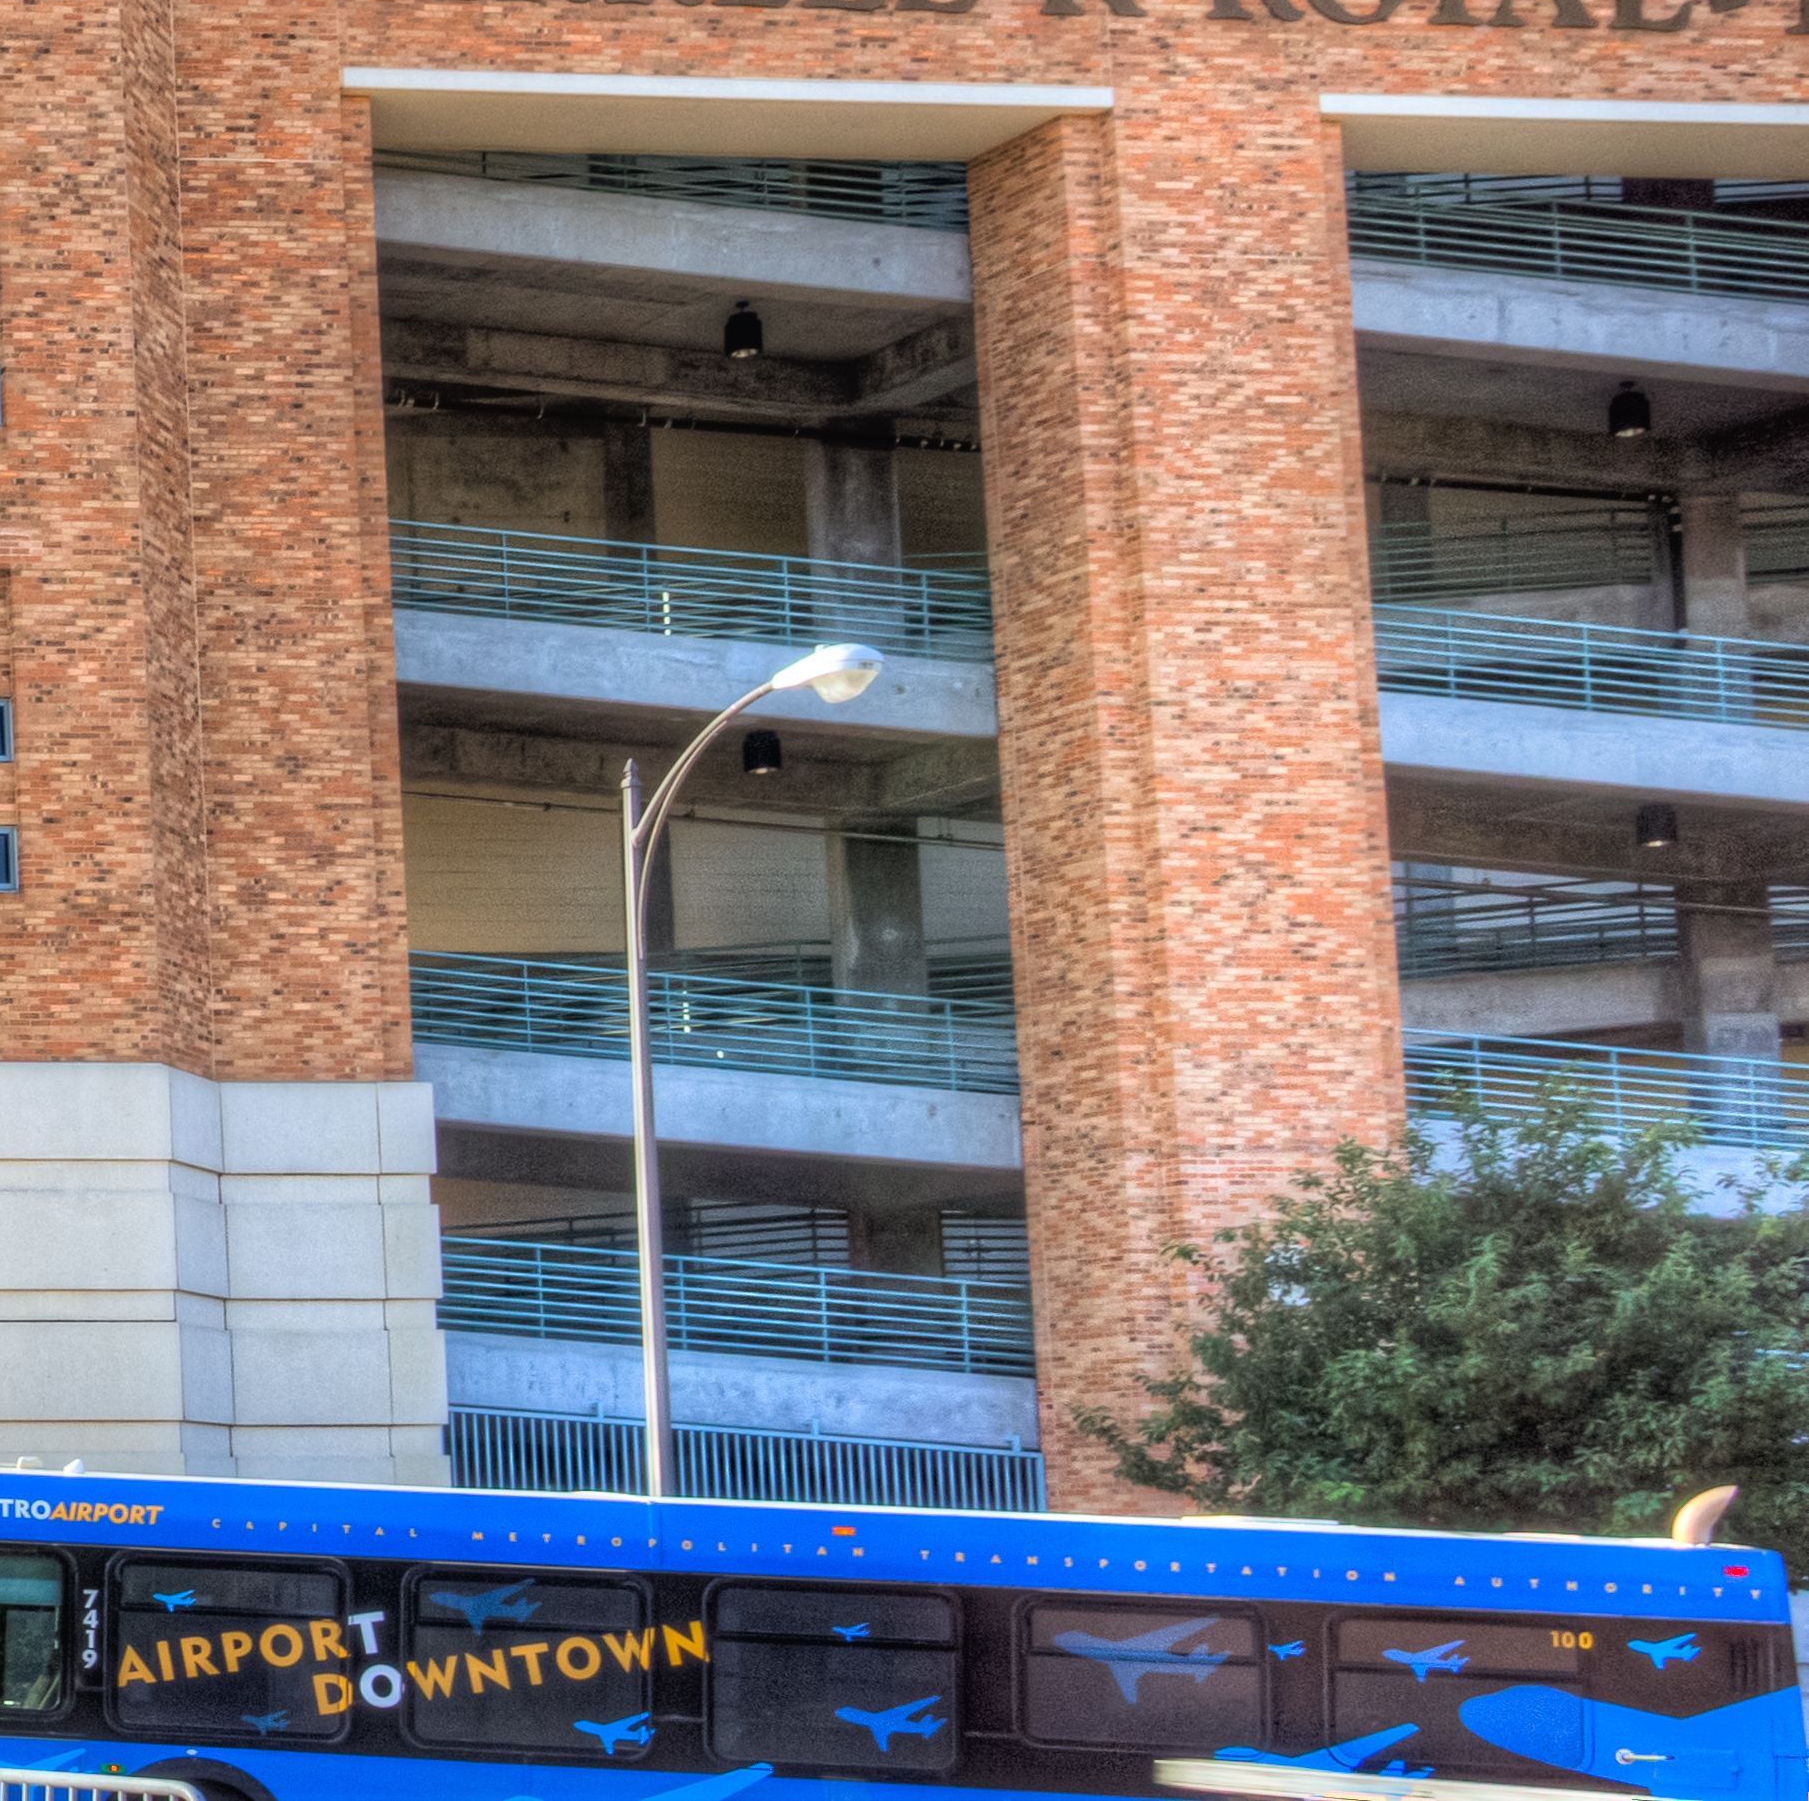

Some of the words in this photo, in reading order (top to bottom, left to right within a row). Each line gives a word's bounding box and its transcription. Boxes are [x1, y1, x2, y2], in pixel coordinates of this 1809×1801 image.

[211, 1517, 417, 1538] CAPITAL
[471, 1531, 864, 1557] METROPOLITAN
[919, 1549, 1396, 1582] TRANSPORTATION
[1454, 1575, 1762, 1600] AUTHORITY
[82, 1588, 99, 1670] 7419
[117, 1610, 386, 1688] AIRPORT
[310, 1620, 711, 1717] DOWNTOWN
[1550, 1629, 1594, 1650] 100
